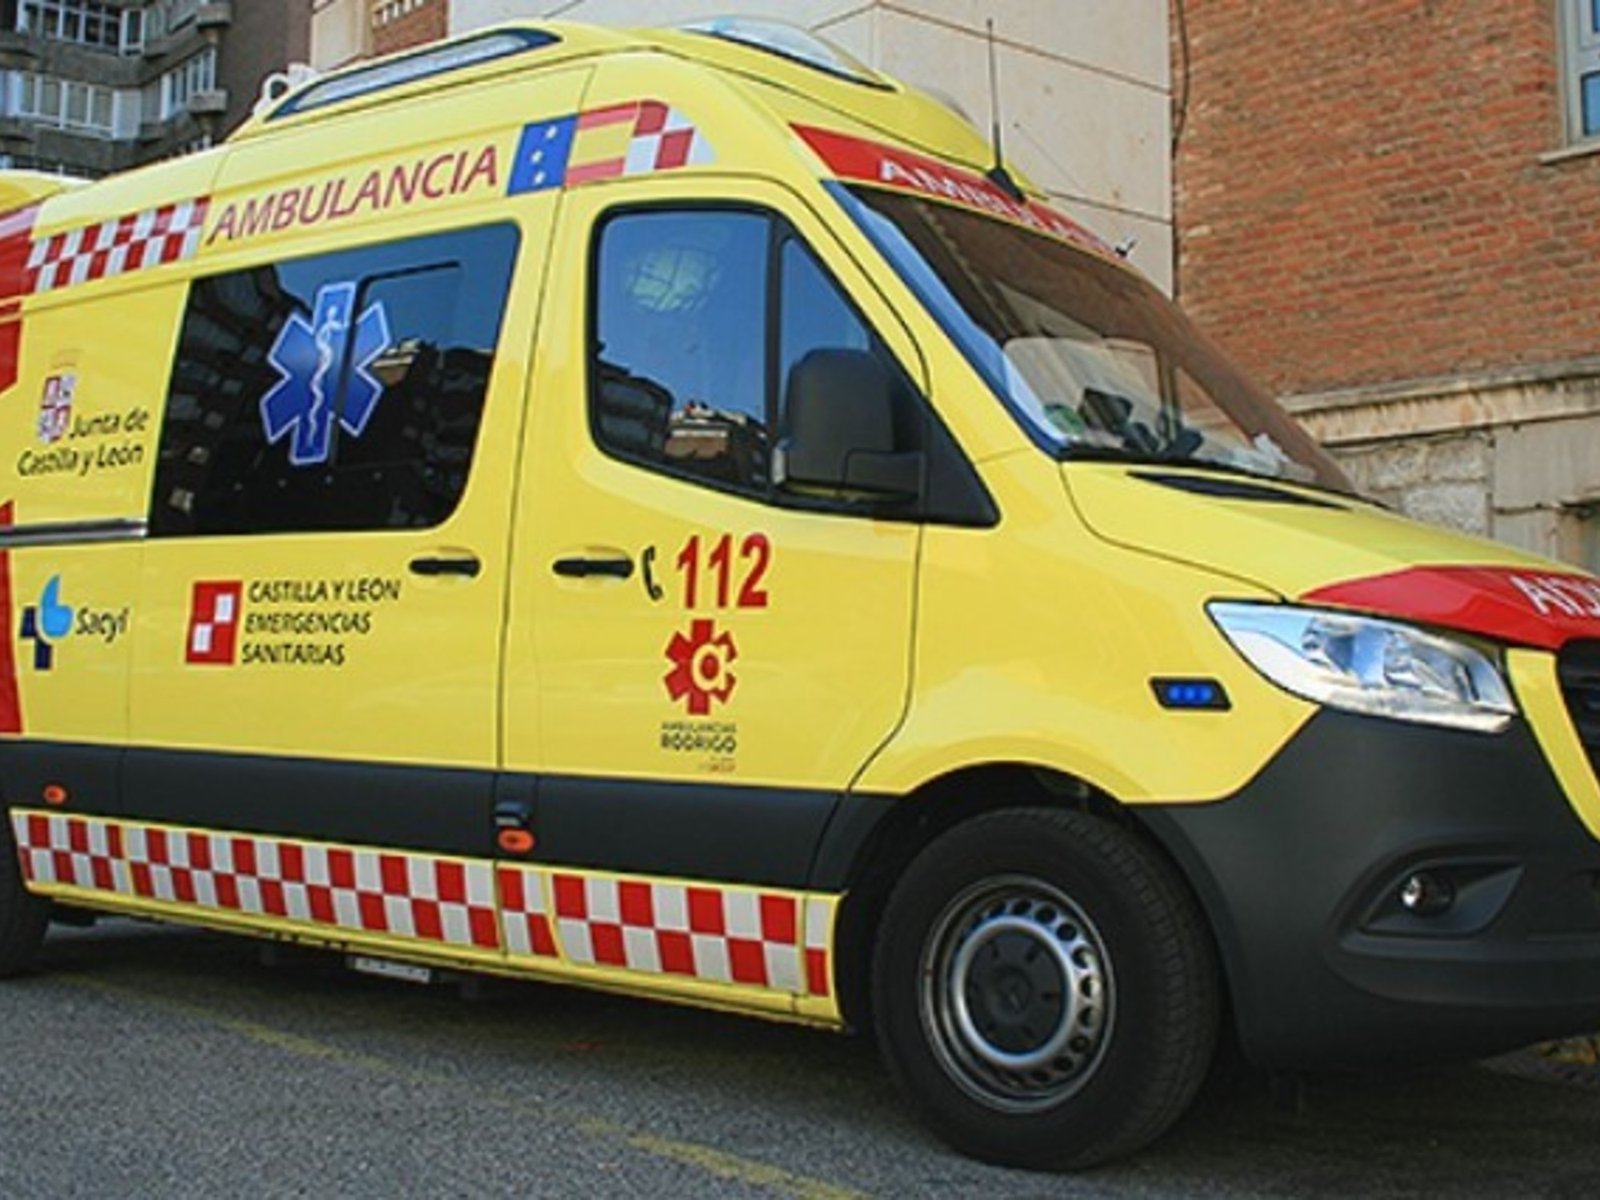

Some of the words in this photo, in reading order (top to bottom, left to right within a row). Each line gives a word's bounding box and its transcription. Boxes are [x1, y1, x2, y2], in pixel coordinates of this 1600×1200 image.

[206, 145, 498, 246] AMBULANCIA
[79, 453, 94, 476] y
[677, 532, 770, 609] 112
[249, 579, 328, 602] CASTILLA
[332, 579, 345, 600] Y
[246, 611, 371, 635] EMERGENCIAS
[242, 642, 345, 665] SANITARIAS
